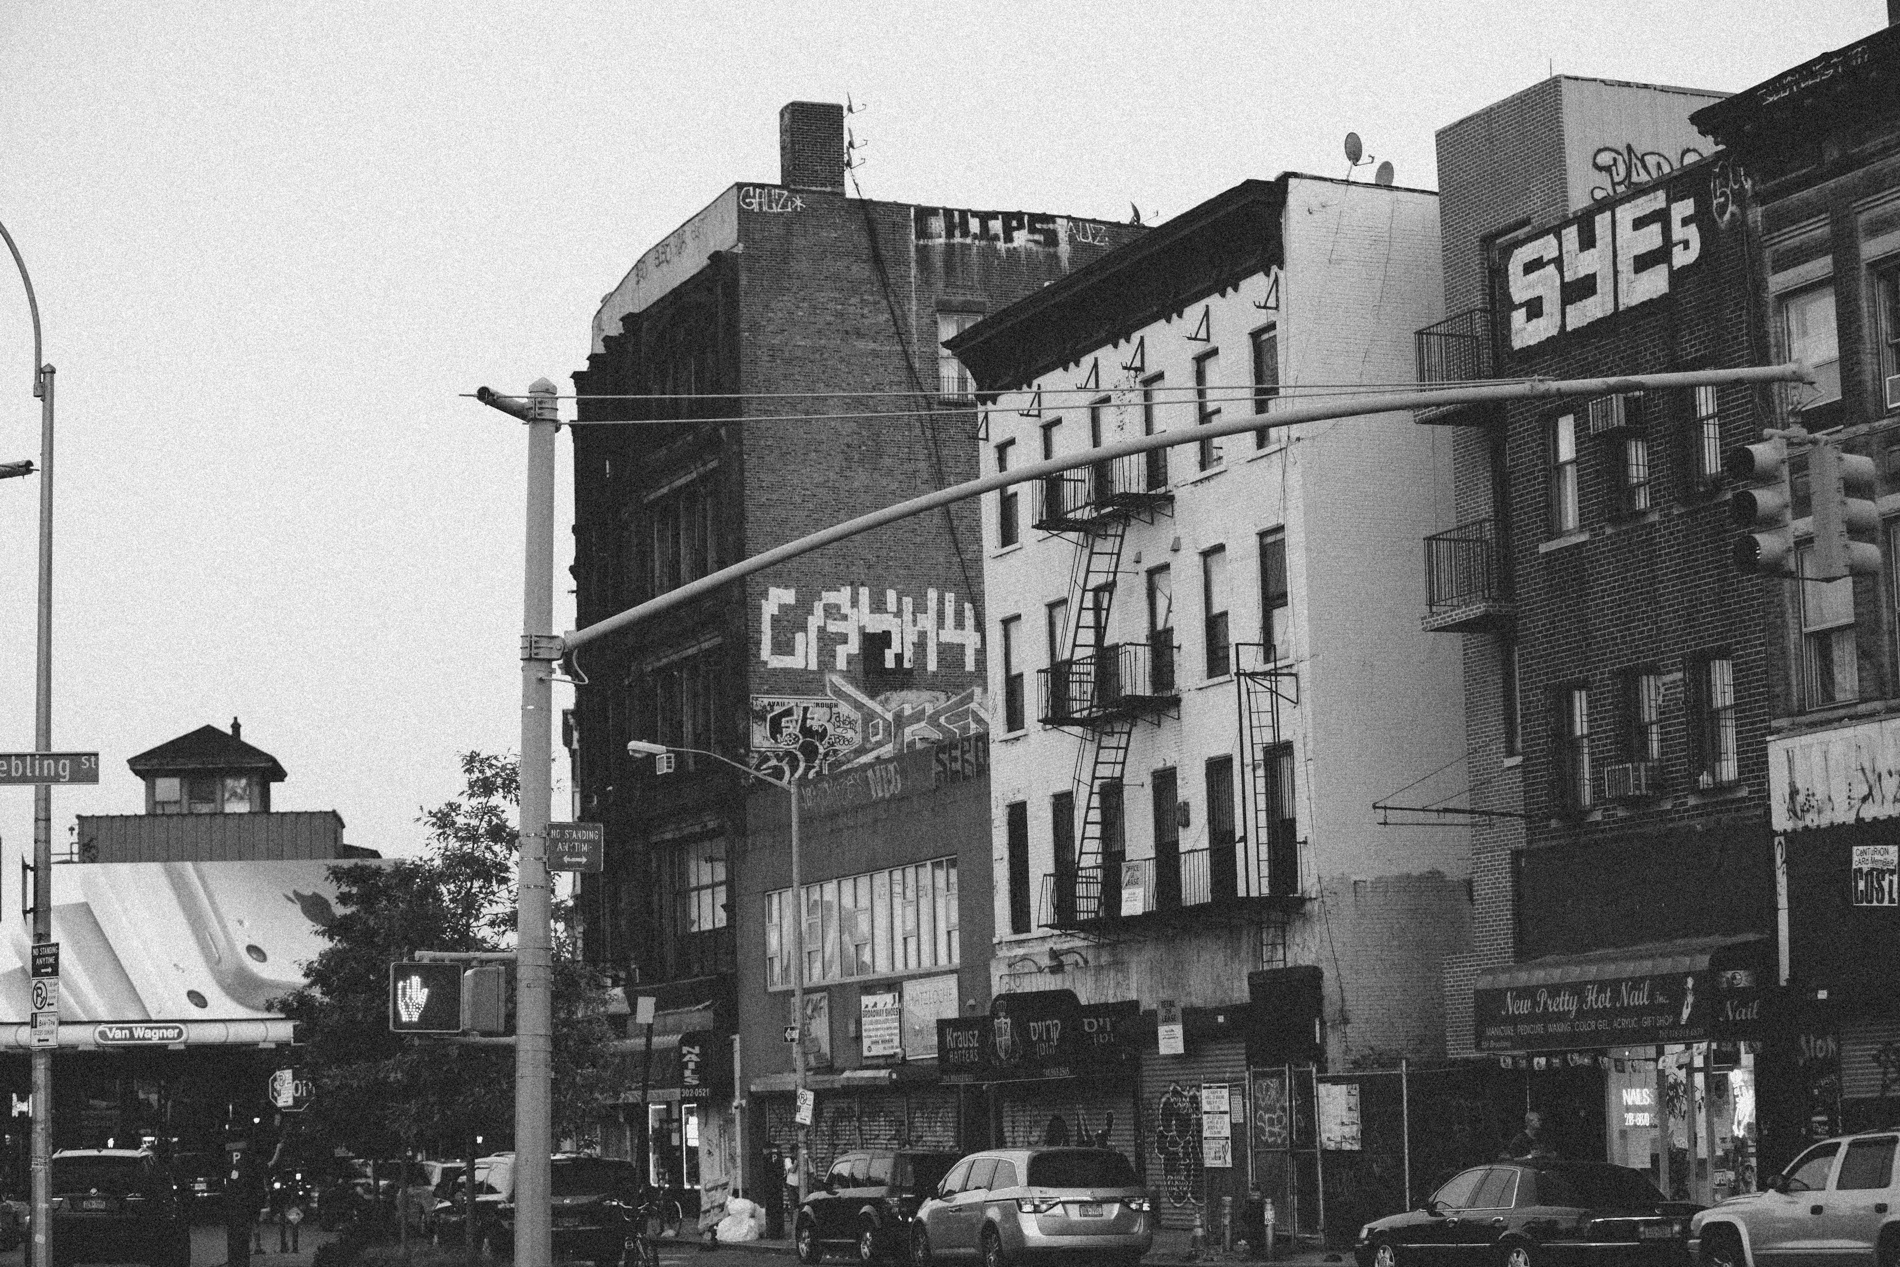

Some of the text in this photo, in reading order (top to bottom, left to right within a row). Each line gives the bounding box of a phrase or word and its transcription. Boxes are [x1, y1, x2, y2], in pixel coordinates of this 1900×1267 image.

[81, 755, 96, 768] St
[551, 829, 599, 840] NO STANDING
[1852, 867, 1897, 905] COST
[1502, 991, 1532, 1015] New
[1535, 989, 1579, 1019] Pretty
[1583, 984, 1611, 1010] Hot
[1616, 980, 1650, 1007] Nail
[1719, 1000, 1760, 1021] Nail
[105, 1026, 179, 1041] Van Wagner
[1485, 1026, 1514, 1037] MANICURE
[1517, 1023, 1544, 1035] PEDICURE
[1574, 1020, 1596, 1032] COLOR
[1641, 1017, 1656, 1028] GIFT
[1656, 1015, 1674, 1026] SHOP
[946, 1028, 979, 1049] Krausz
[949, 1049, 979, 1063] HATTERS
[1622, 1088, 1650, 1106] NAILS
